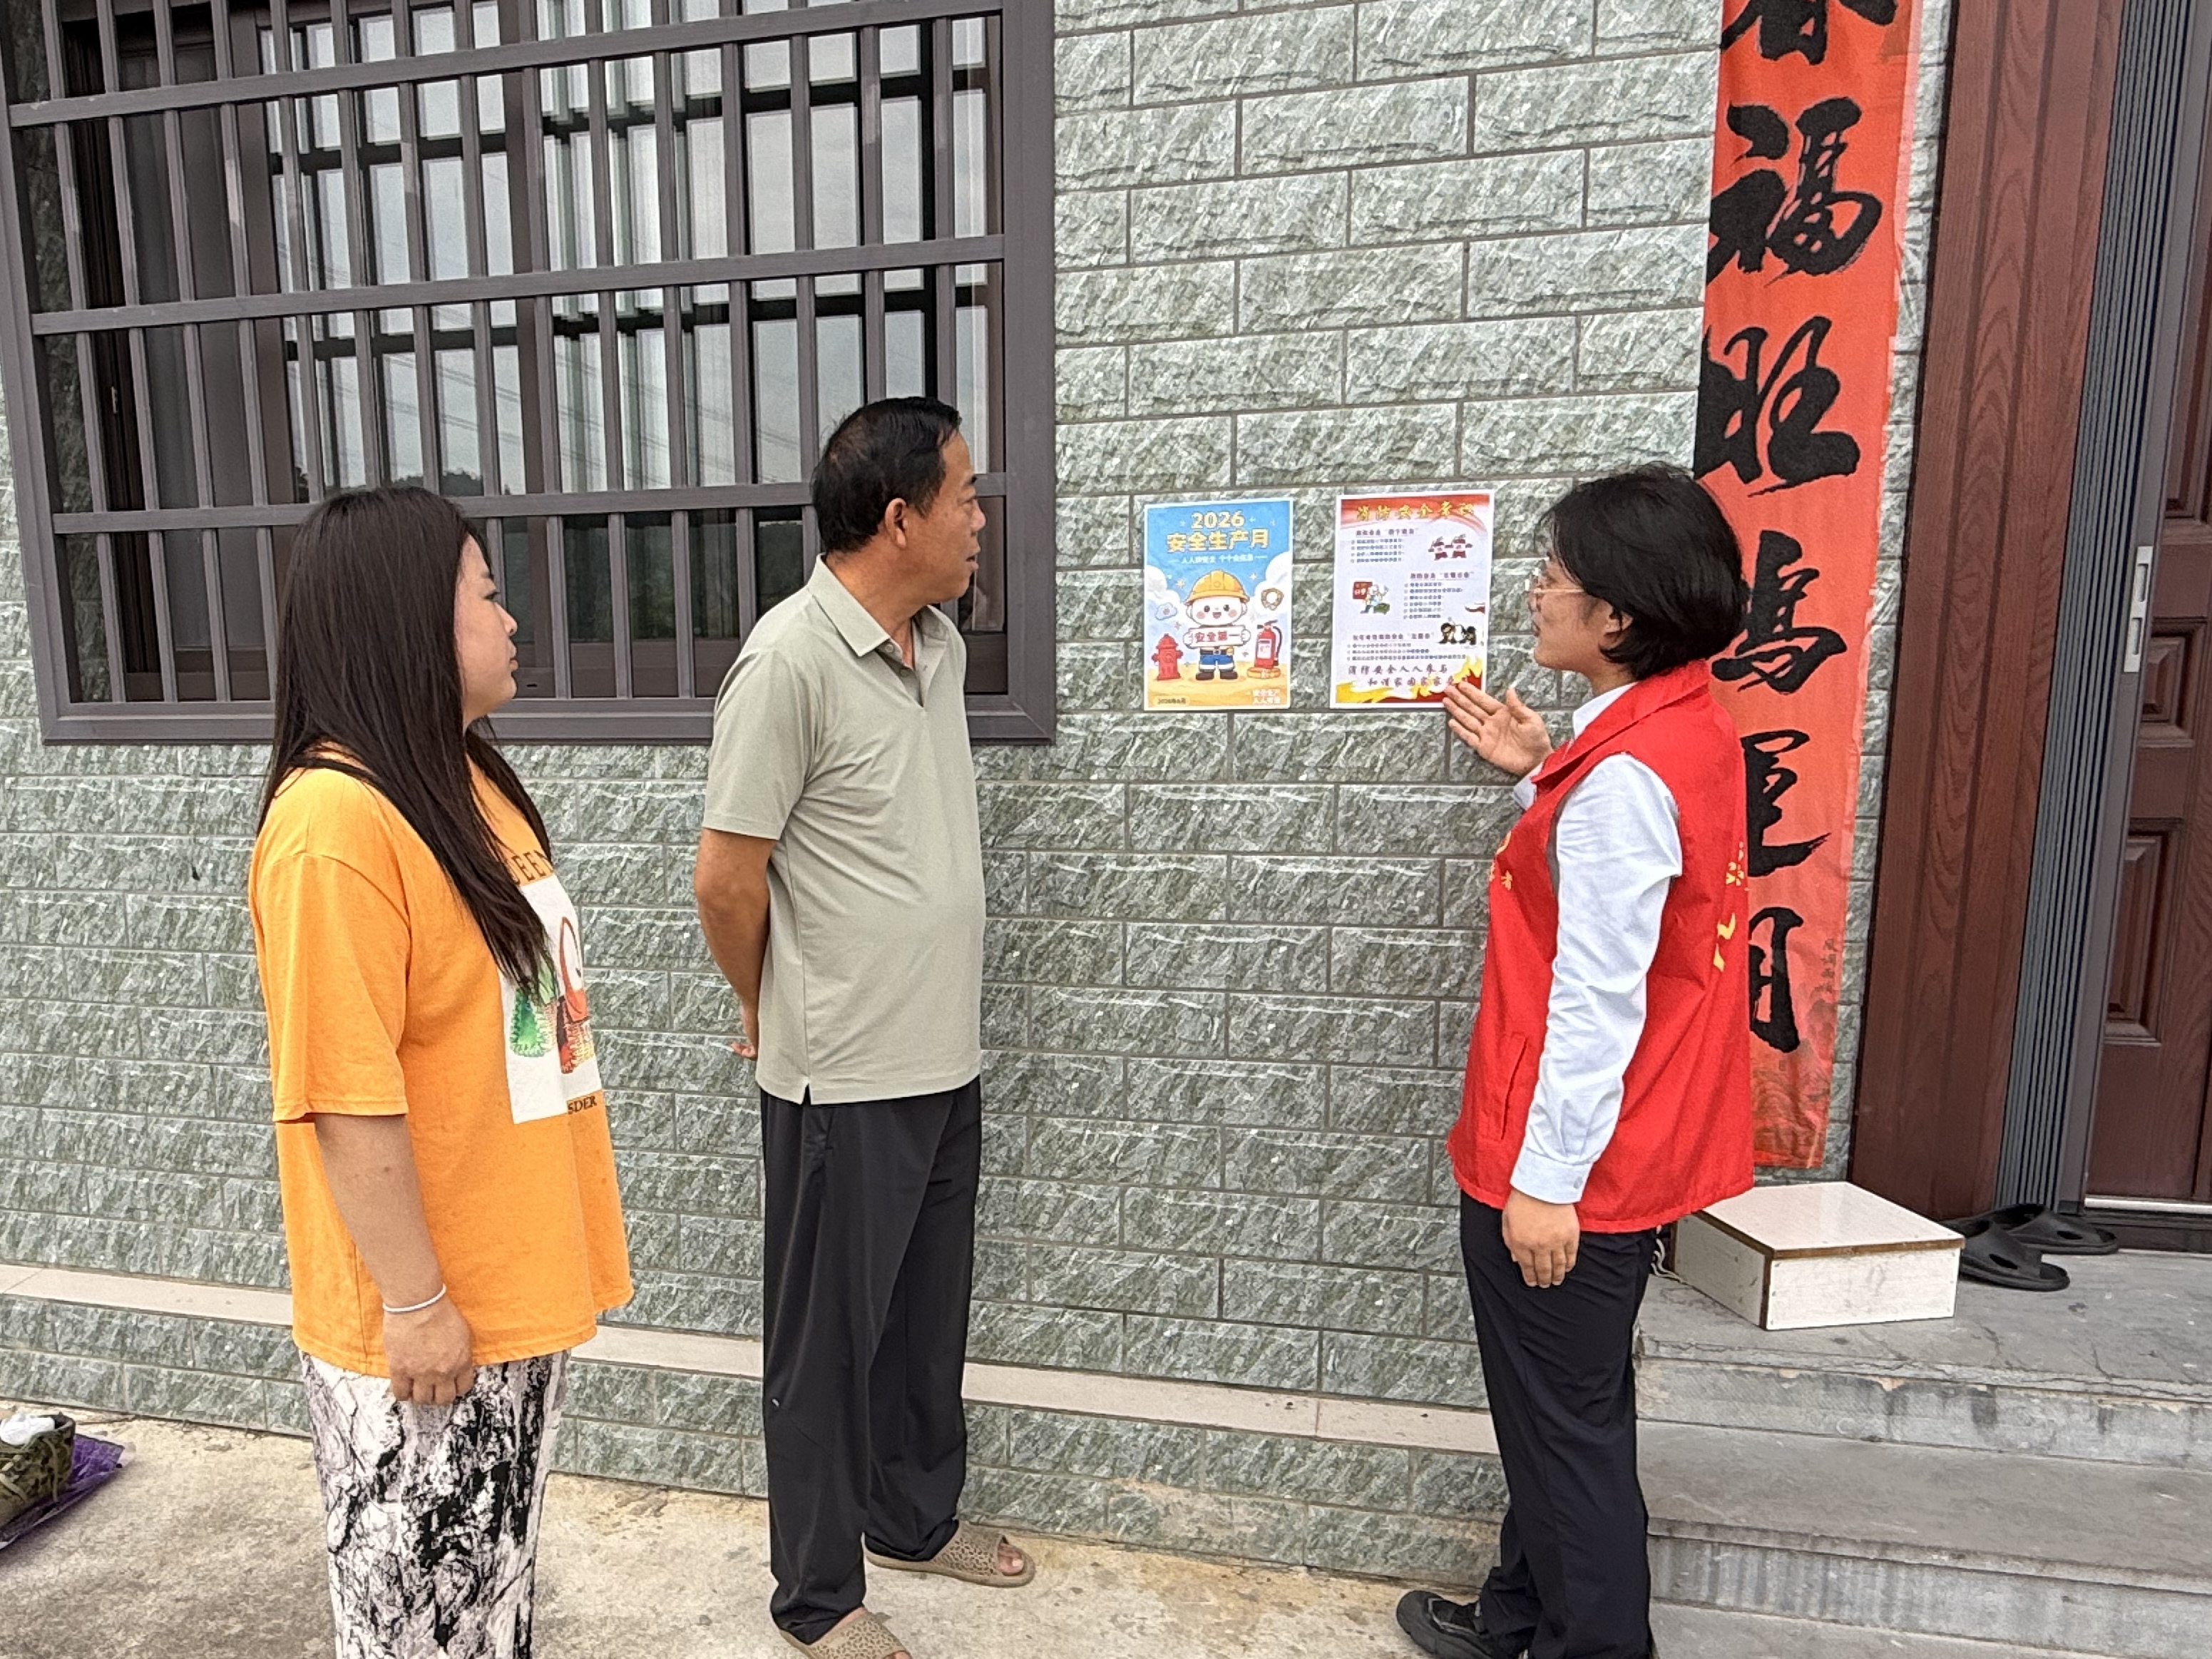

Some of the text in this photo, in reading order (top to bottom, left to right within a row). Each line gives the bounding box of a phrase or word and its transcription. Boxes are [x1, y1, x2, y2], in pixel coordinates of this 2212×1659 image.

[1191, 510, 1246, 529] 2026
[1167, 529, 1269, 553] 安全生产月
